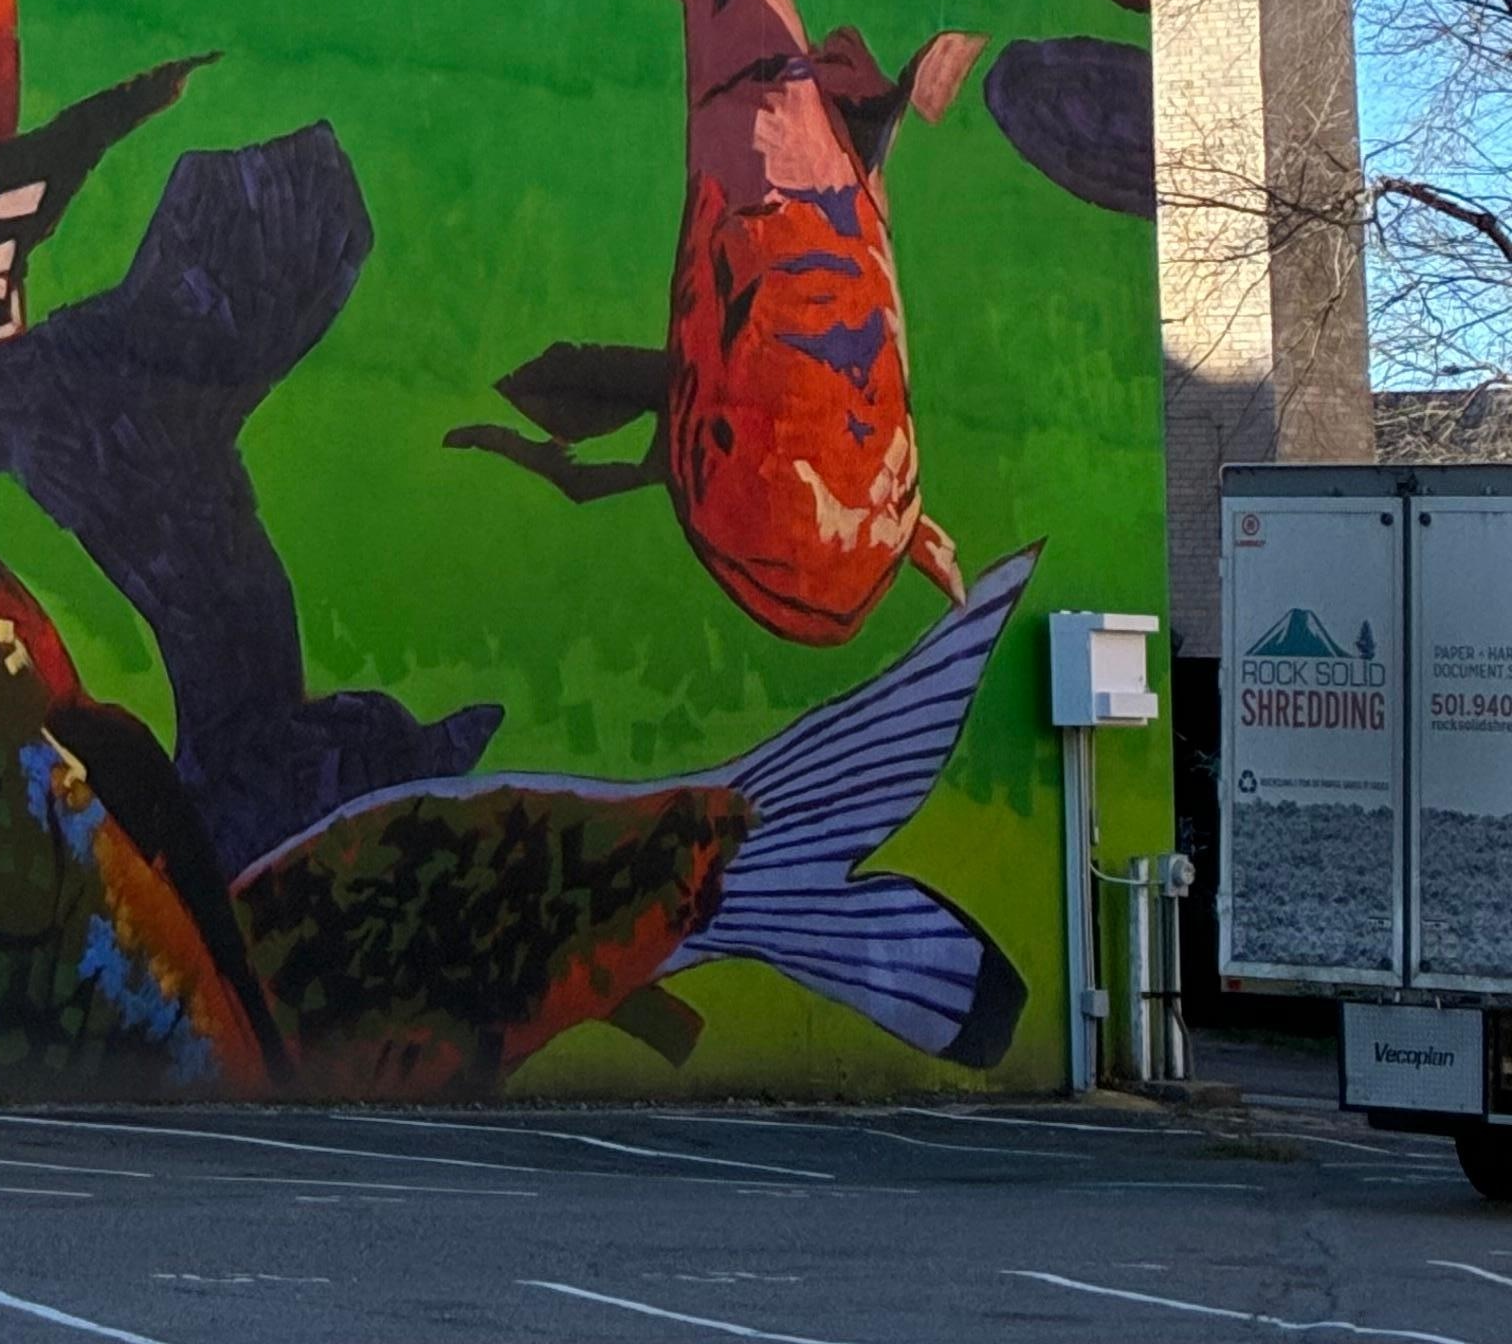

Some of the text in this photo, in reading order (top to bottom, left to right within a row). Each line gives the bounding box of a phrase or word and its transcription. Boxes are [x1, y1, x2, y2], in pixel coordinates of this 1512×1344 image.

[1433, 645, 1475, 661] PAPER
[1241, 660, 1386, 688] ROCK SOLID
[1433, 663, 1505, 680] DOCUMENT
[1241, 688, 1386, 730] SHREDDING
[1374, 1041, 1455, 1070] Vecoplan
